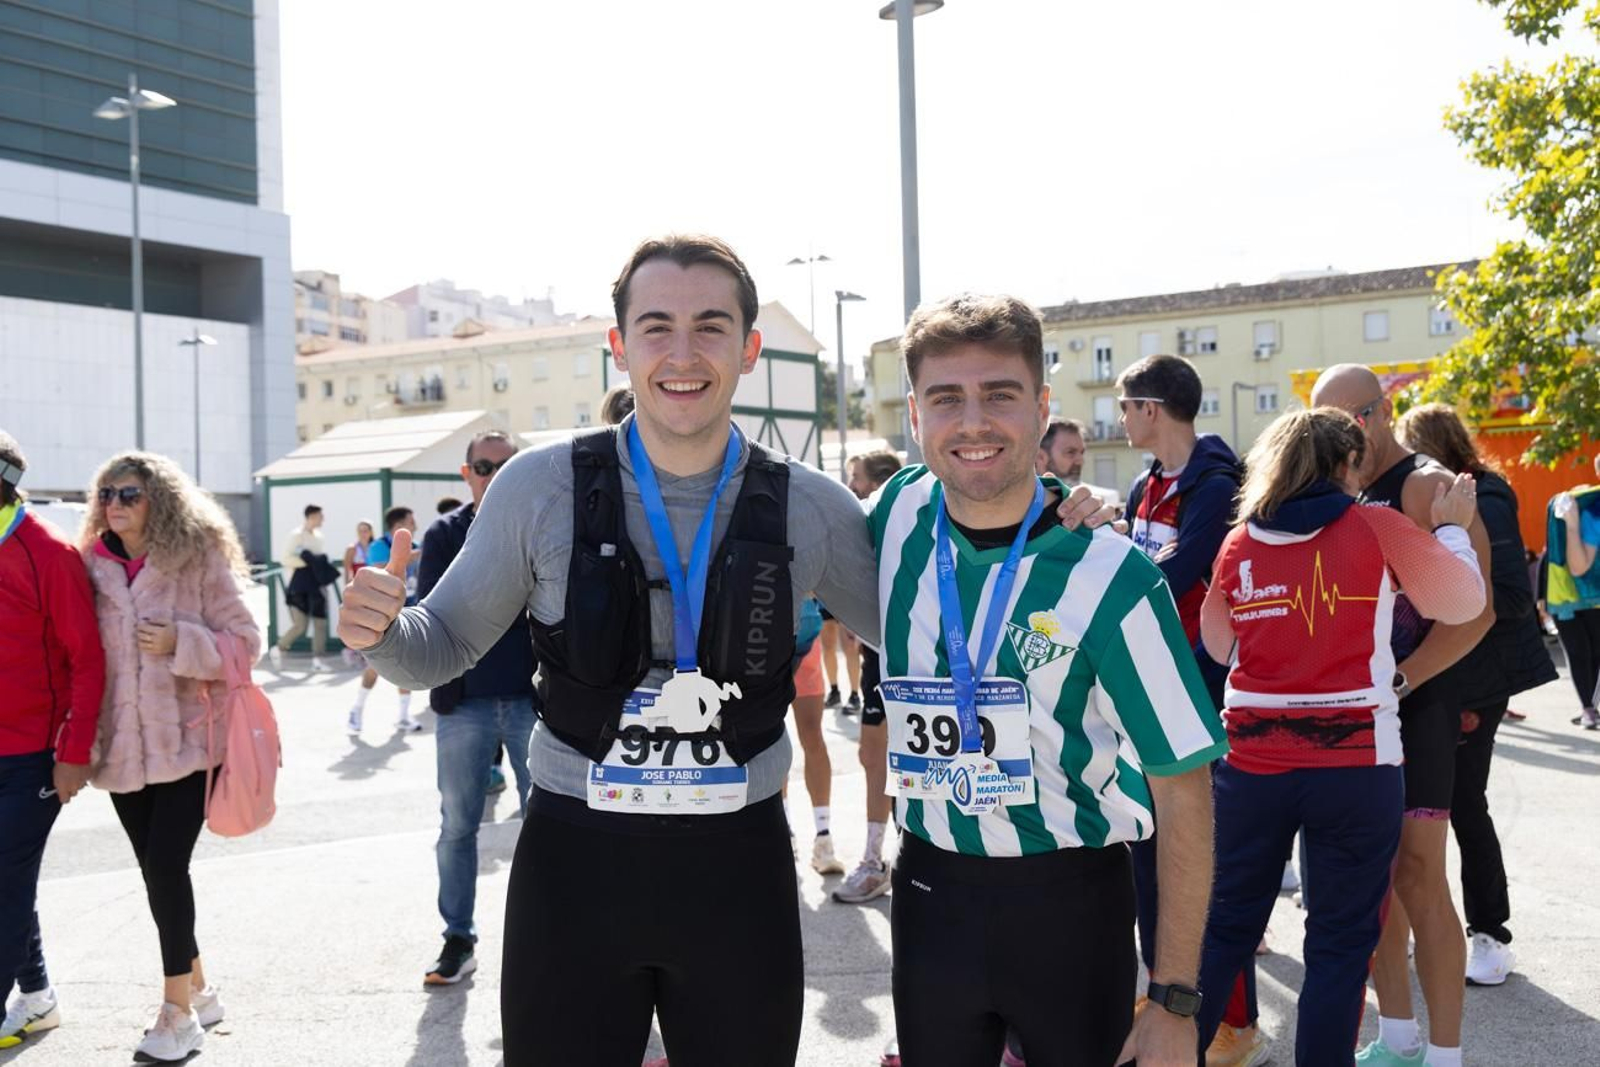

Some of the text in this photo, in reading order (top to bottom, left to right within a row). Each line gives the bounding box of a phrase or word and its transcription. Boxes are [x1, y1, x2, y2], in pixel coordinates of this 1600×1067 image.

[745, 561, 779, 675] KIPRUN
[641, 770, 702, 780] JOSE PABLO
[977, 774, 1007, 783] MEDIA
[975, 796, 997, 805] JAÉN
